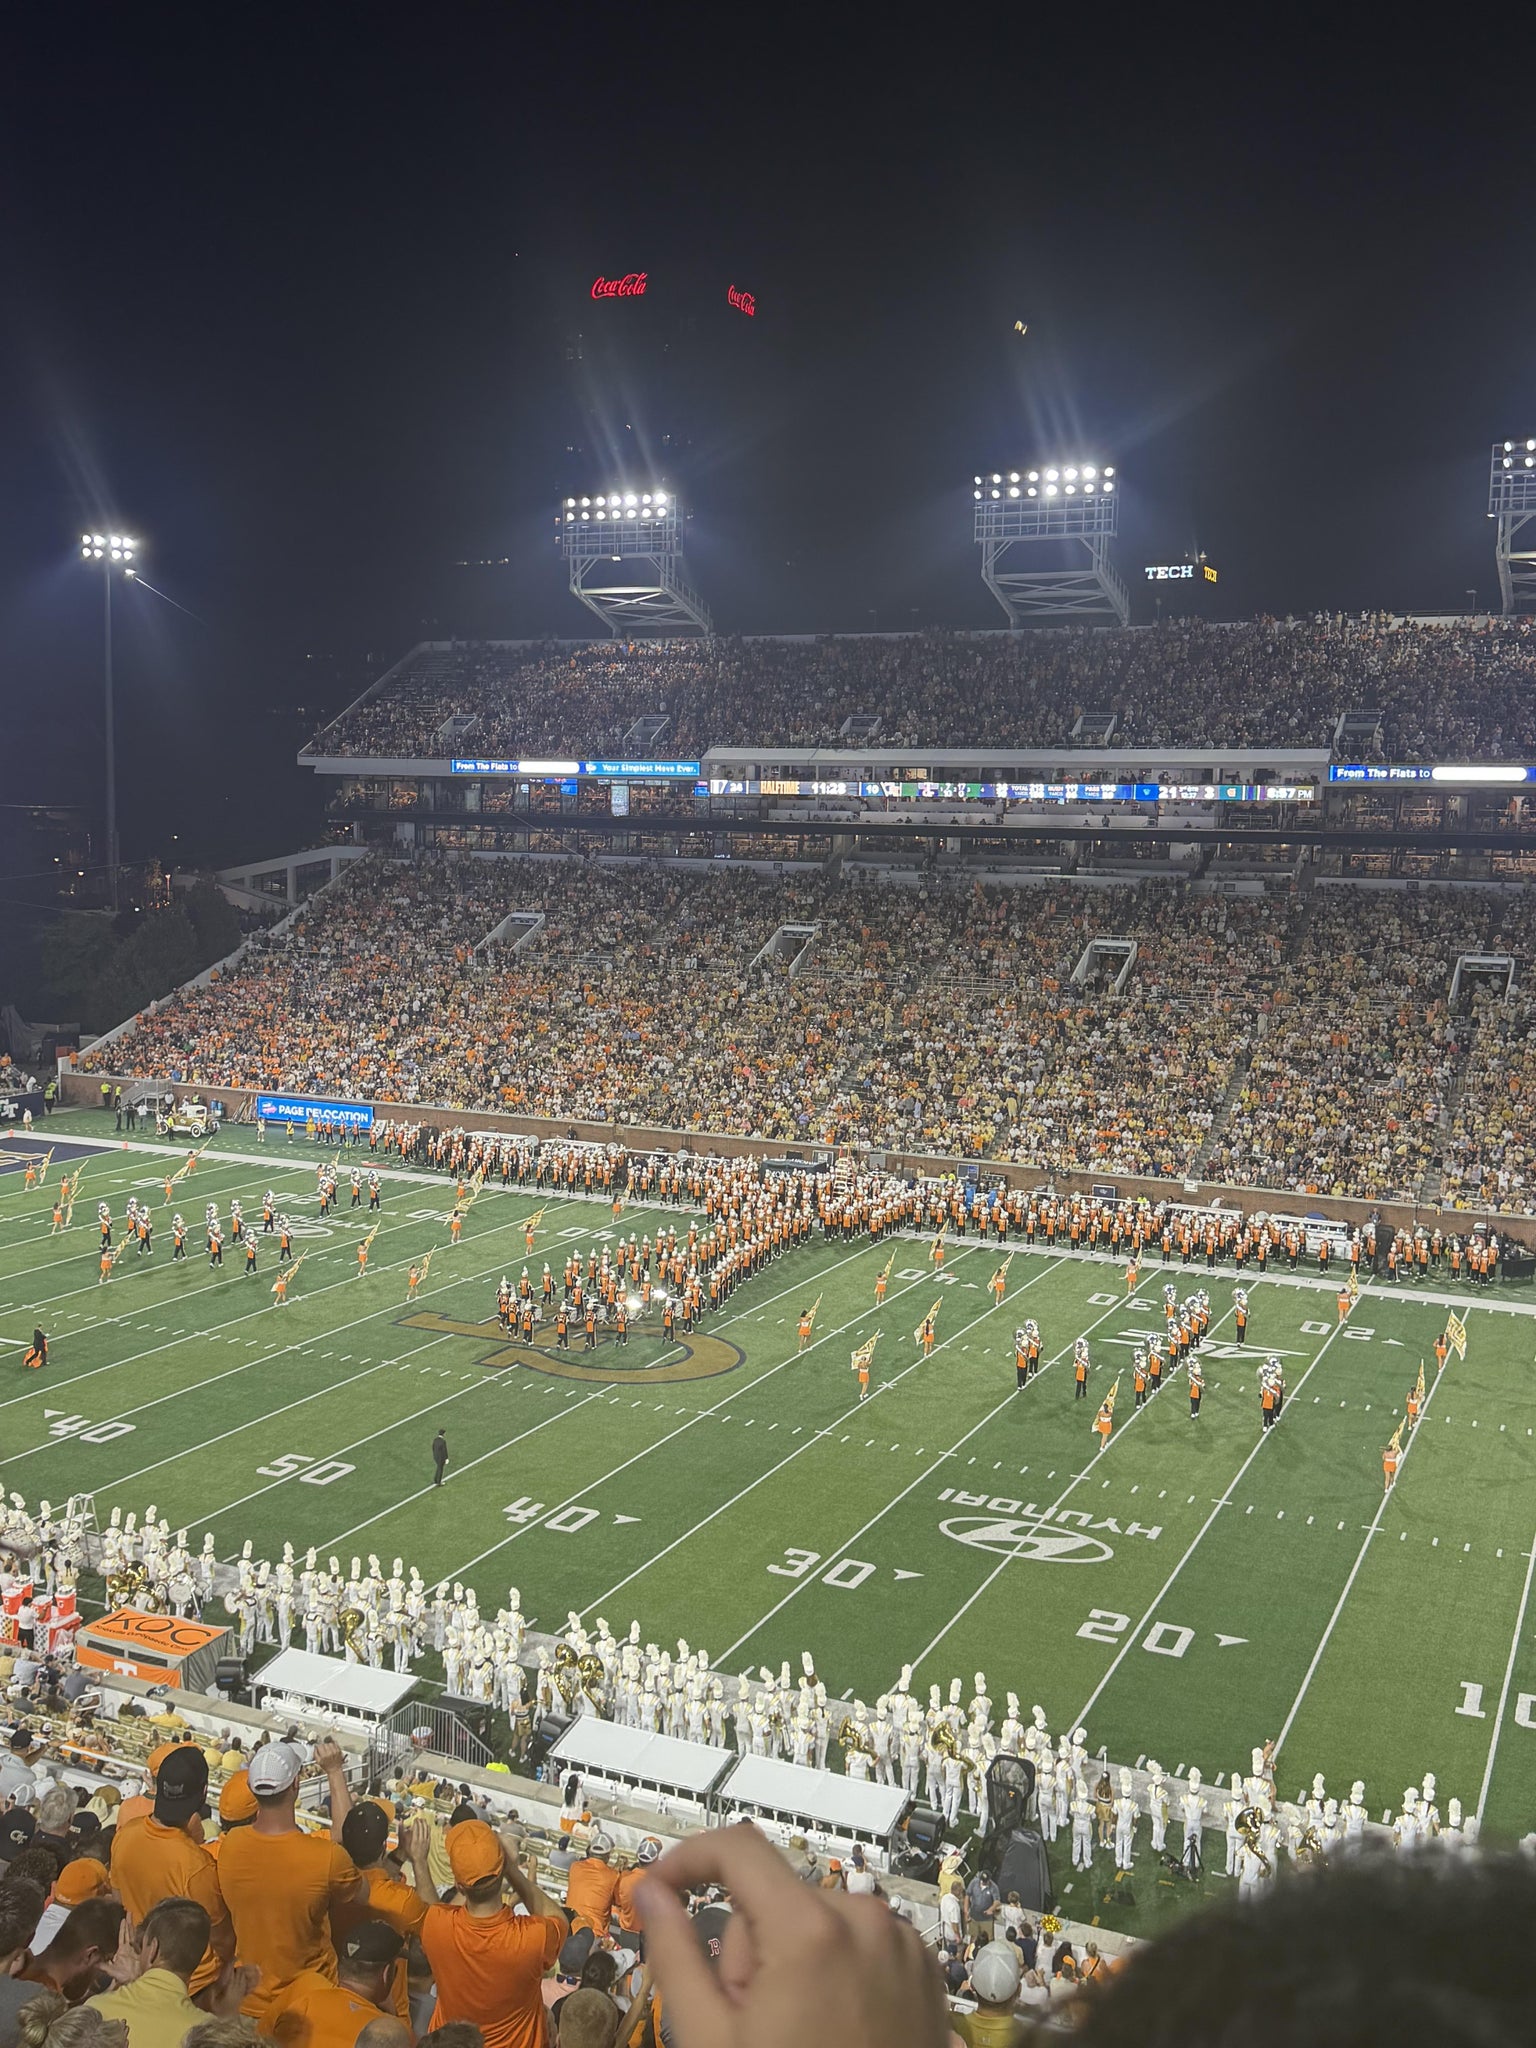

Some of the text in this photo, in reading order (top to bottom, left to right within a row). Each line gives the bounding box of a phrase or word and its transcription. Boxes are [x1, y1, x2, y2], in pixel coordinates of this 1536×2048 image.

[1145, 565, 1194, 580] TECH
[1203, 565, 1218, 583] TECH
[456, 763, 475, 771] From
[476, 763, 490, 771] The
[509, 763, 518, 772] to
[602, 763, 619, 772] Your
[1336, 768, 1431, 778] From The Flats to
[760, 780, 800, 795] HALFTIME
[1297, 789, 1312, 799] PM
[278, 1104, 305, 1117] PAGE
[1086, 1292, 1159, 1312] 30
[1299, 1320, 1376, 1341] 20
[48, 1414, 137, 1444] 40
[256, 1453, 357, 1486] 50
[502, 1496, 601, 1533] 40
[937, 1487, 1164, 1541] HYUNDAI
[766, 1547, 877, 1590] 30
[102, 1612, 212, 1647] KOC
[1075, 1609, 1196, 1658] 20
[708, 1937, 721, 1957] B
